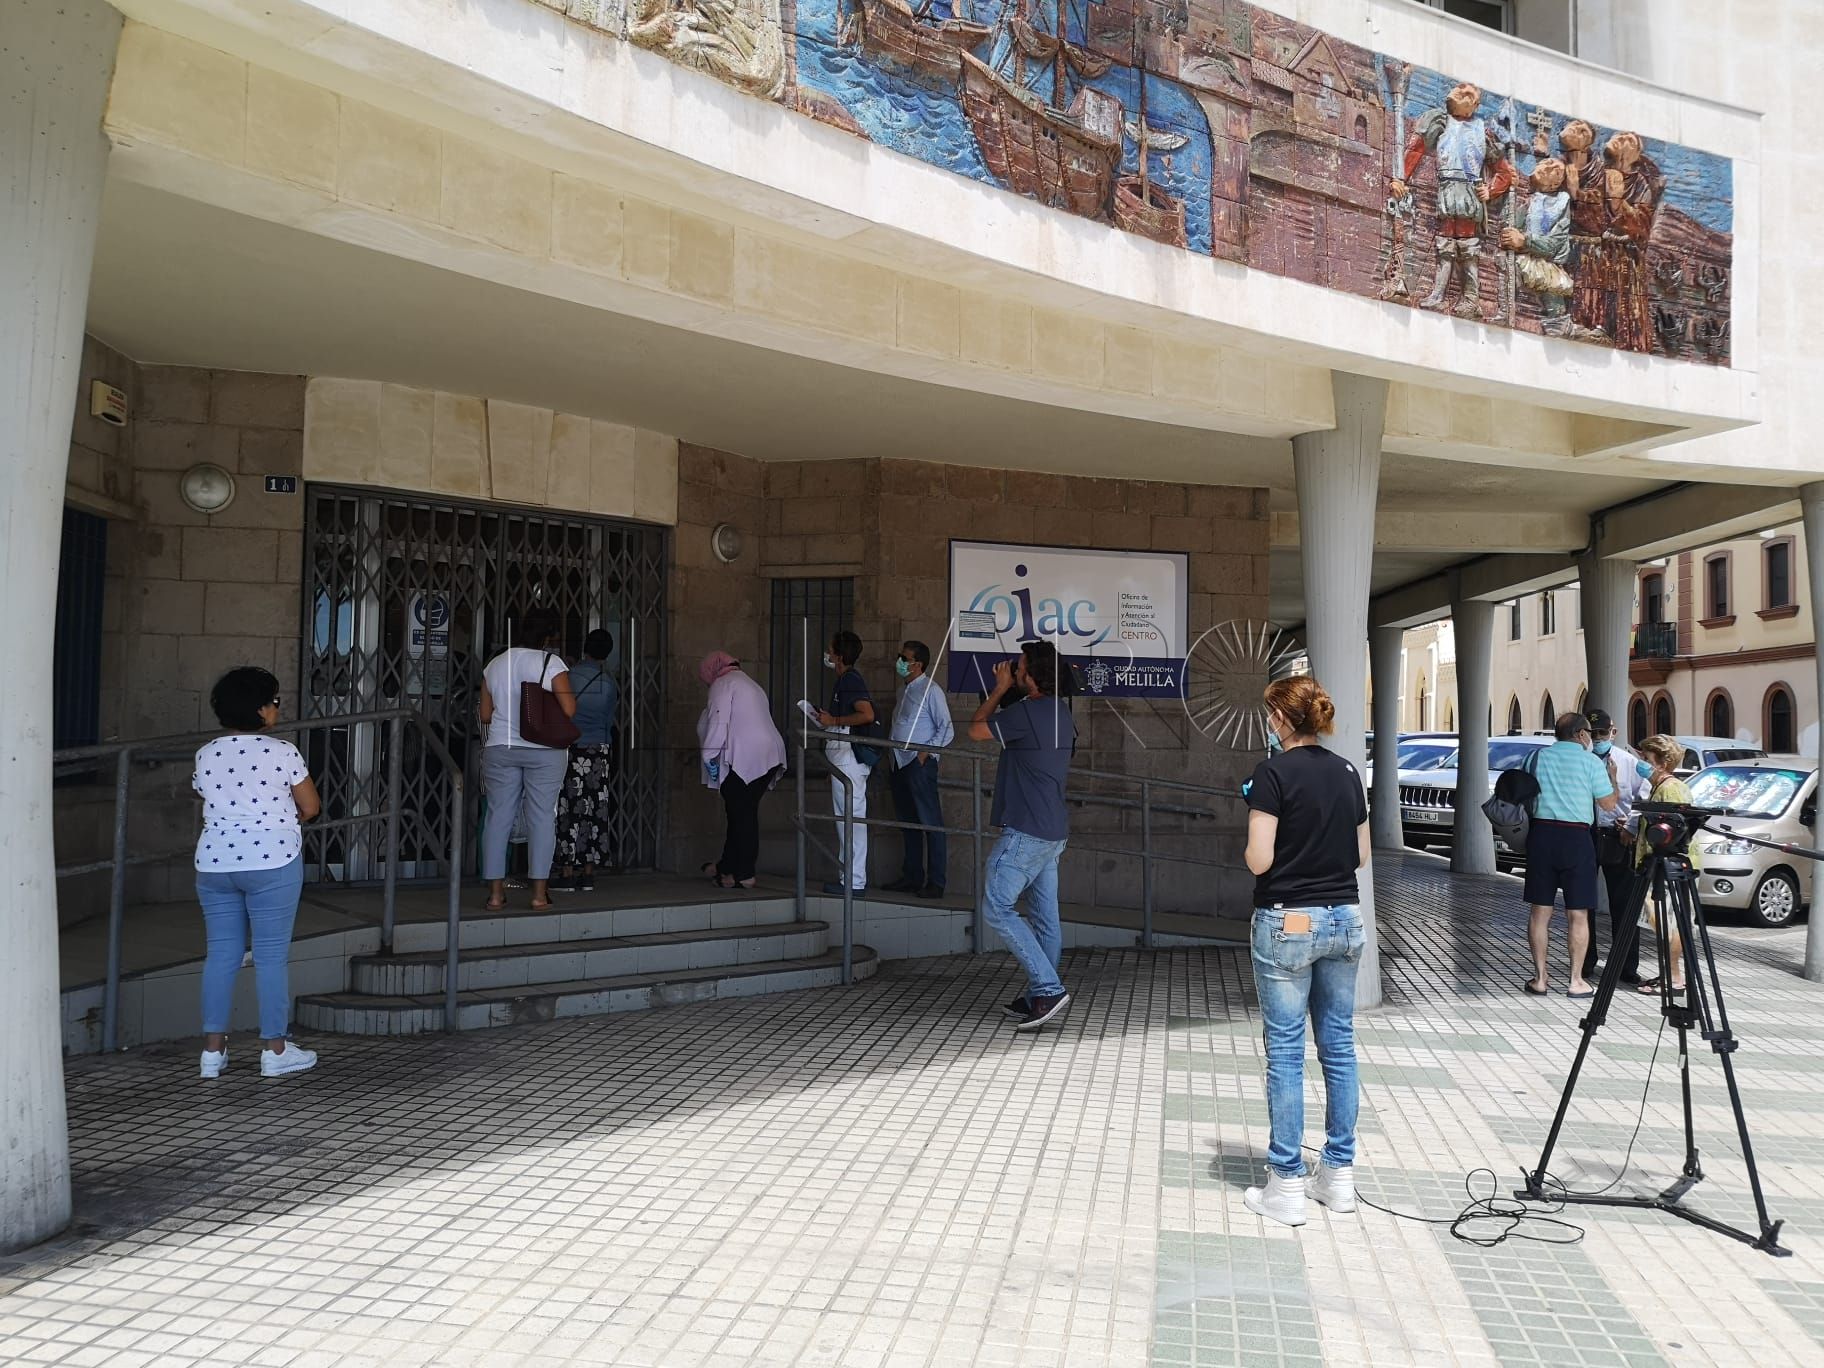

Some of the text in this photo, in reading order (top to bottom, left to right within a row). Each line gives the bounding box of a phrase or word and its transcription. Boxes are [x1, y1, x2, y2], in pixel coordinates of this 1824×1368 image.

[270, 478, 277, 490] 1
[1121, 593, 1140, 601] Oficina
[1125, 611, 1150, 619] Atención
[1121, 631, 1158, 640] CENTRO
[1138, 665, 1175, 673] AUTÓNOMA
[1115, 673, 1175, 687] MELILLA
